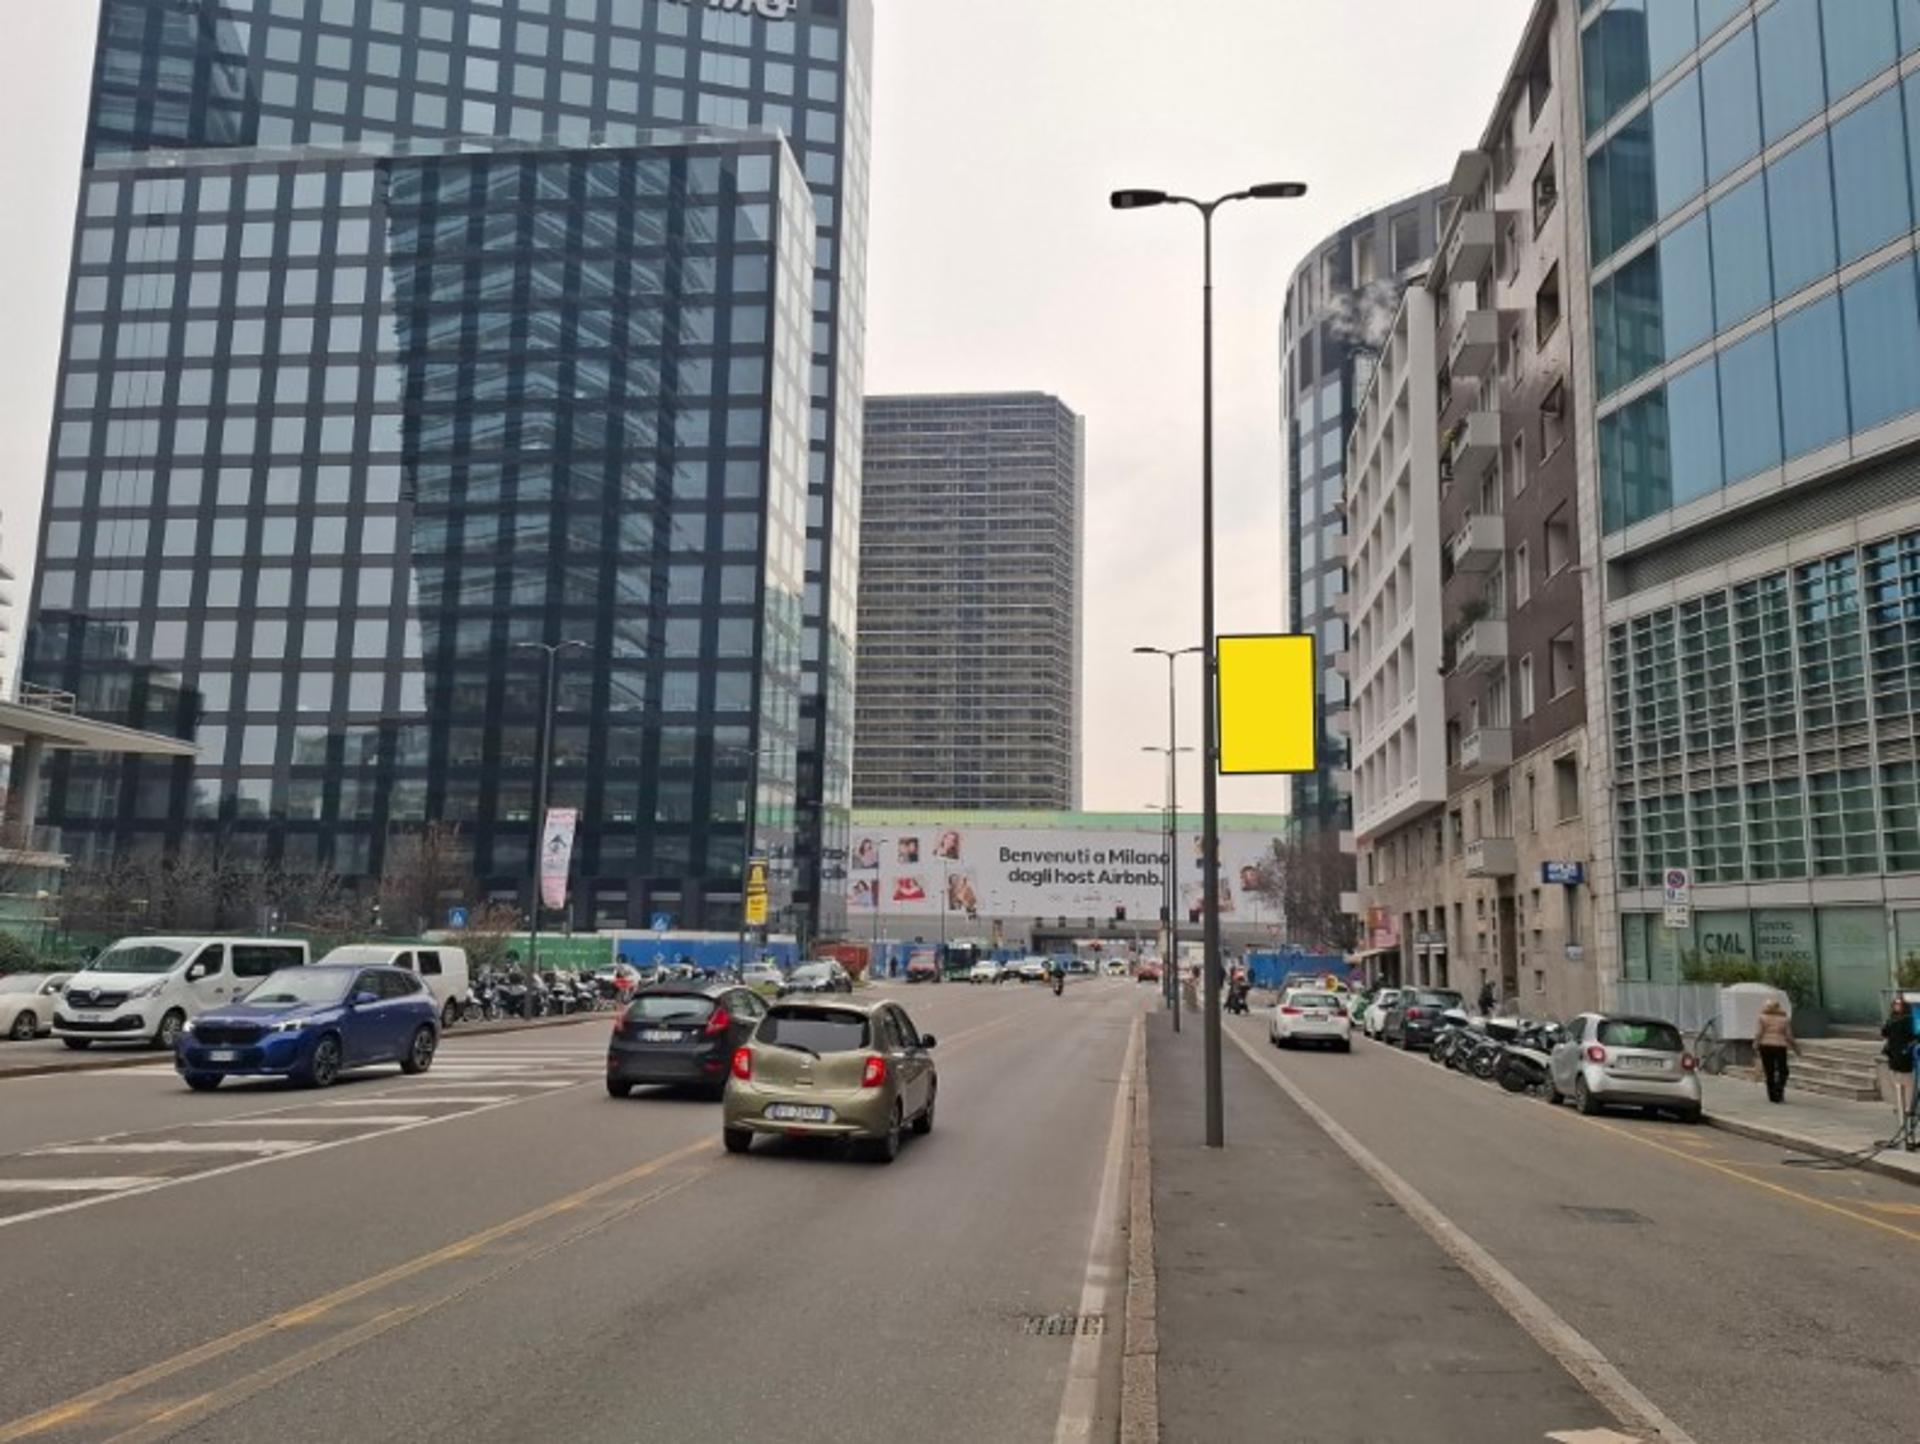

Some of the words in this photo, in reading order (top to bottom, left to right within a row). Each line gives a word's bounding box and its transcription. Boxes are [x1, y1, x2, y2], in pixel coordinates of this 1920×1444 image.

[999, 846, 1090, 864] Benvenuti
[1093, 852, 1105, 865] a
[1109, 848, 1170, 865] Milano
[1008, 867, 1052, 887] dagli
[1055, 868, 1095, 885] host
[1099, 869, 1166, 886] Airbnb.
[1703, 931, 1746, 955] CML
